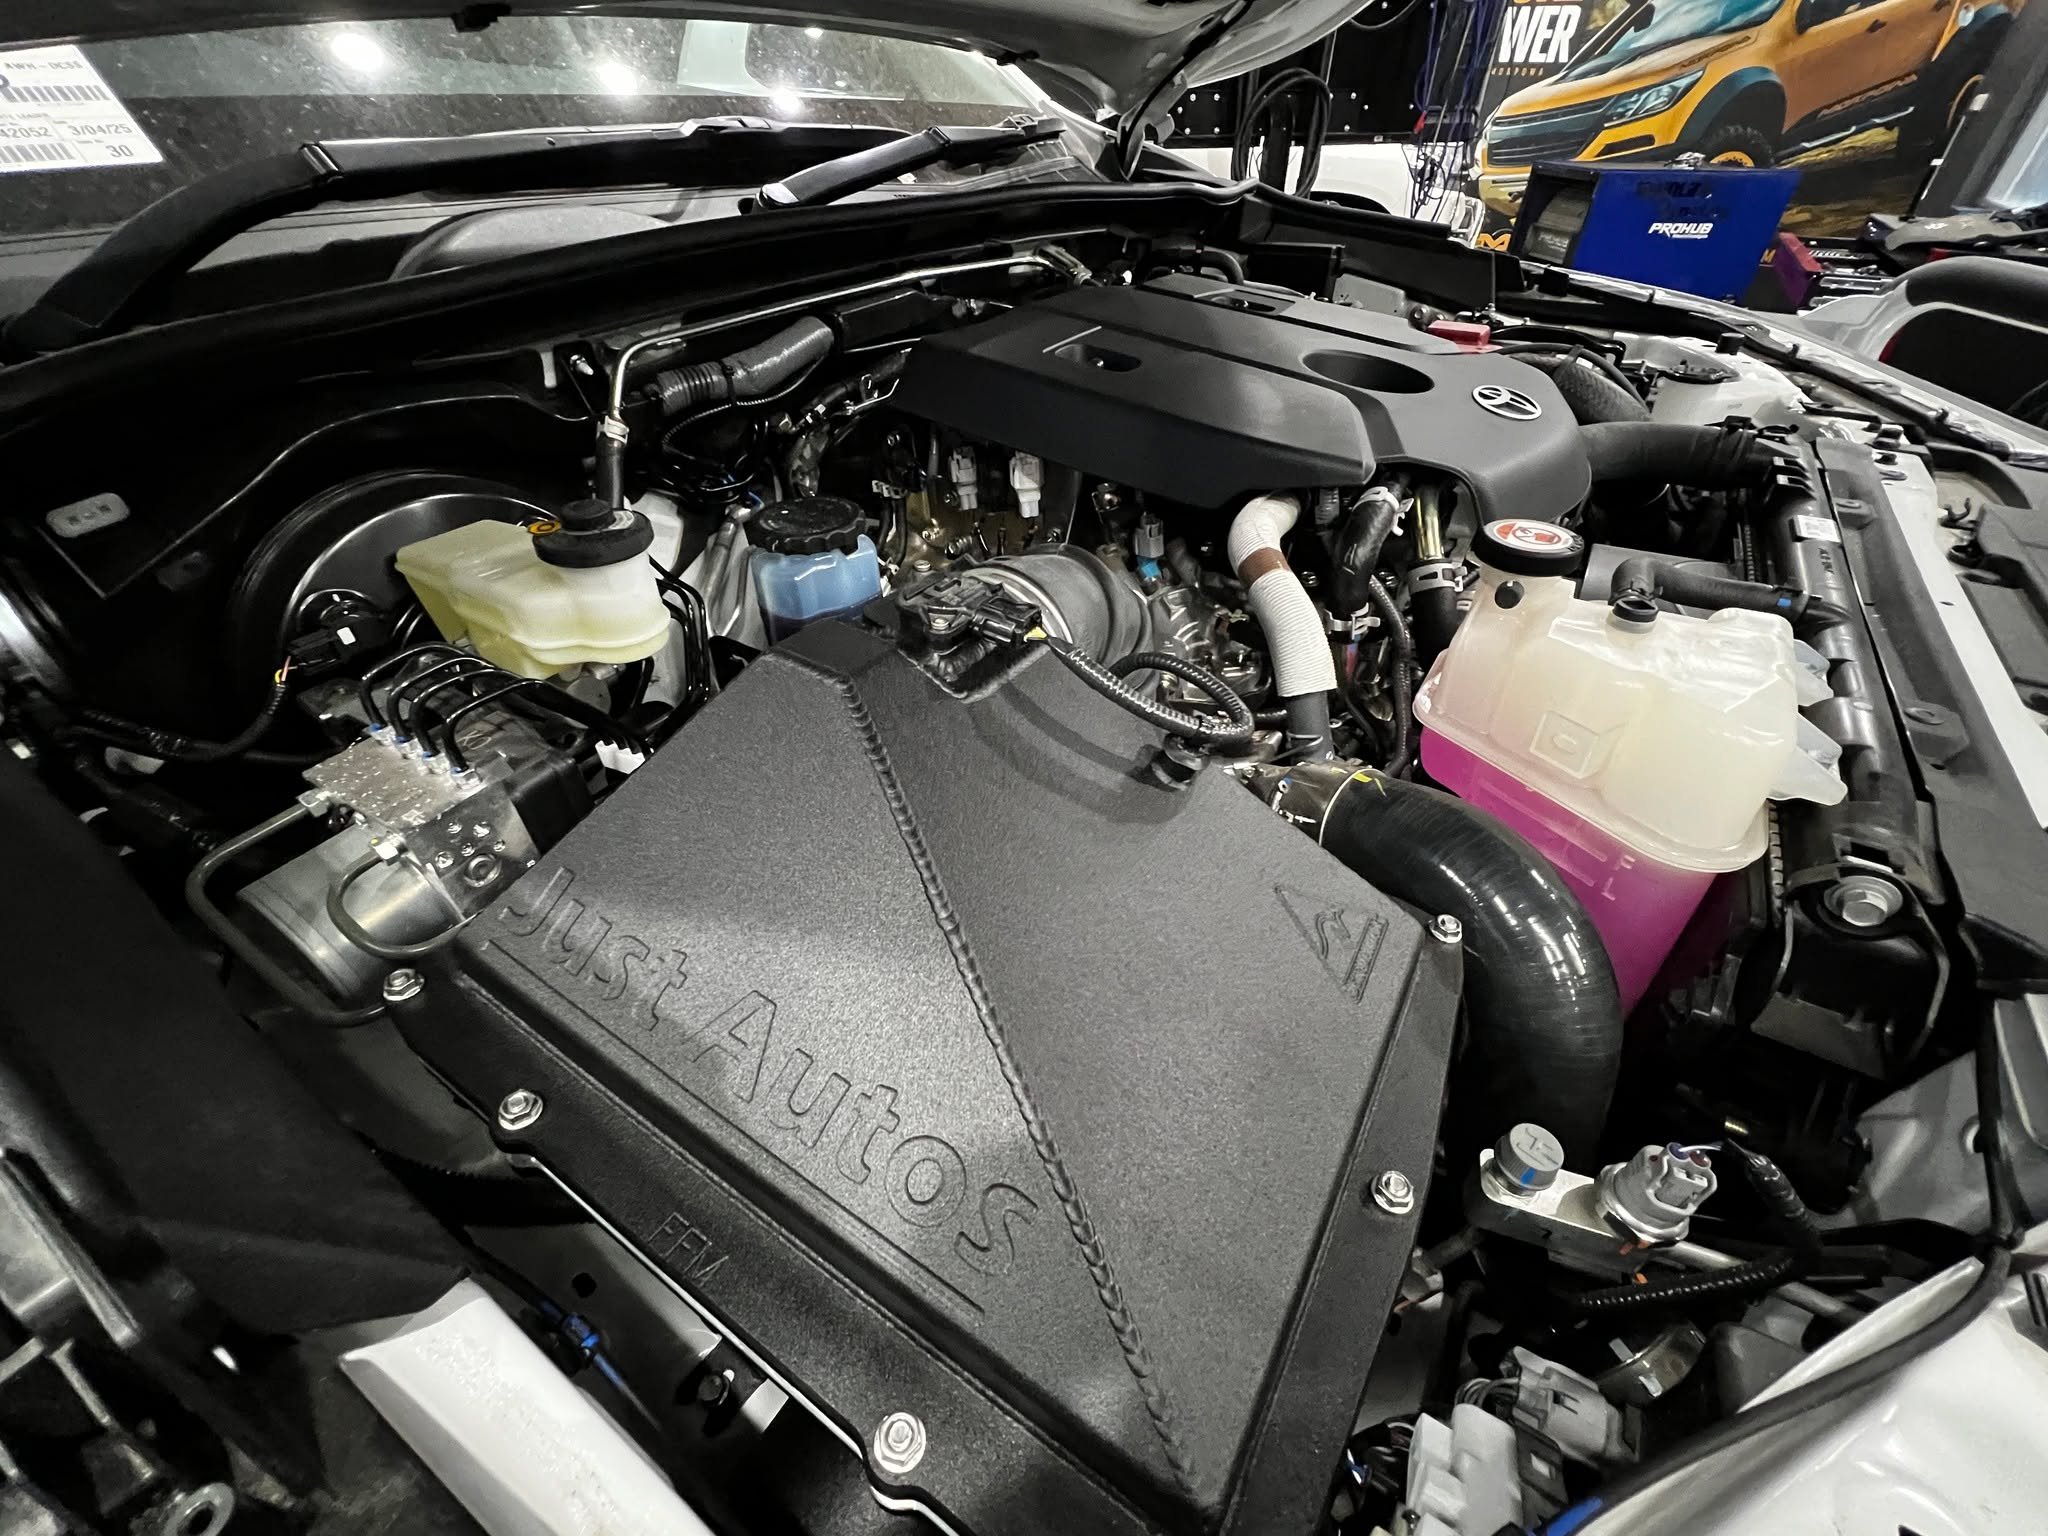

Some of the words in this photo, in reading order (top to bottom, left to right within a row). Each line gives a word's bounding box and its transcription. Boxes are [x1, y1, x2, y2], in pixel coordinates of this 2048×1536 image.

[1498, 5, 1581, 63] WER
[105, 144, 133, 158] 30
[1648, 222, 1714, 237] PROHUB
[501, 865, 688, 1032] Just
[692, 989, 1038, 1276] Autos
